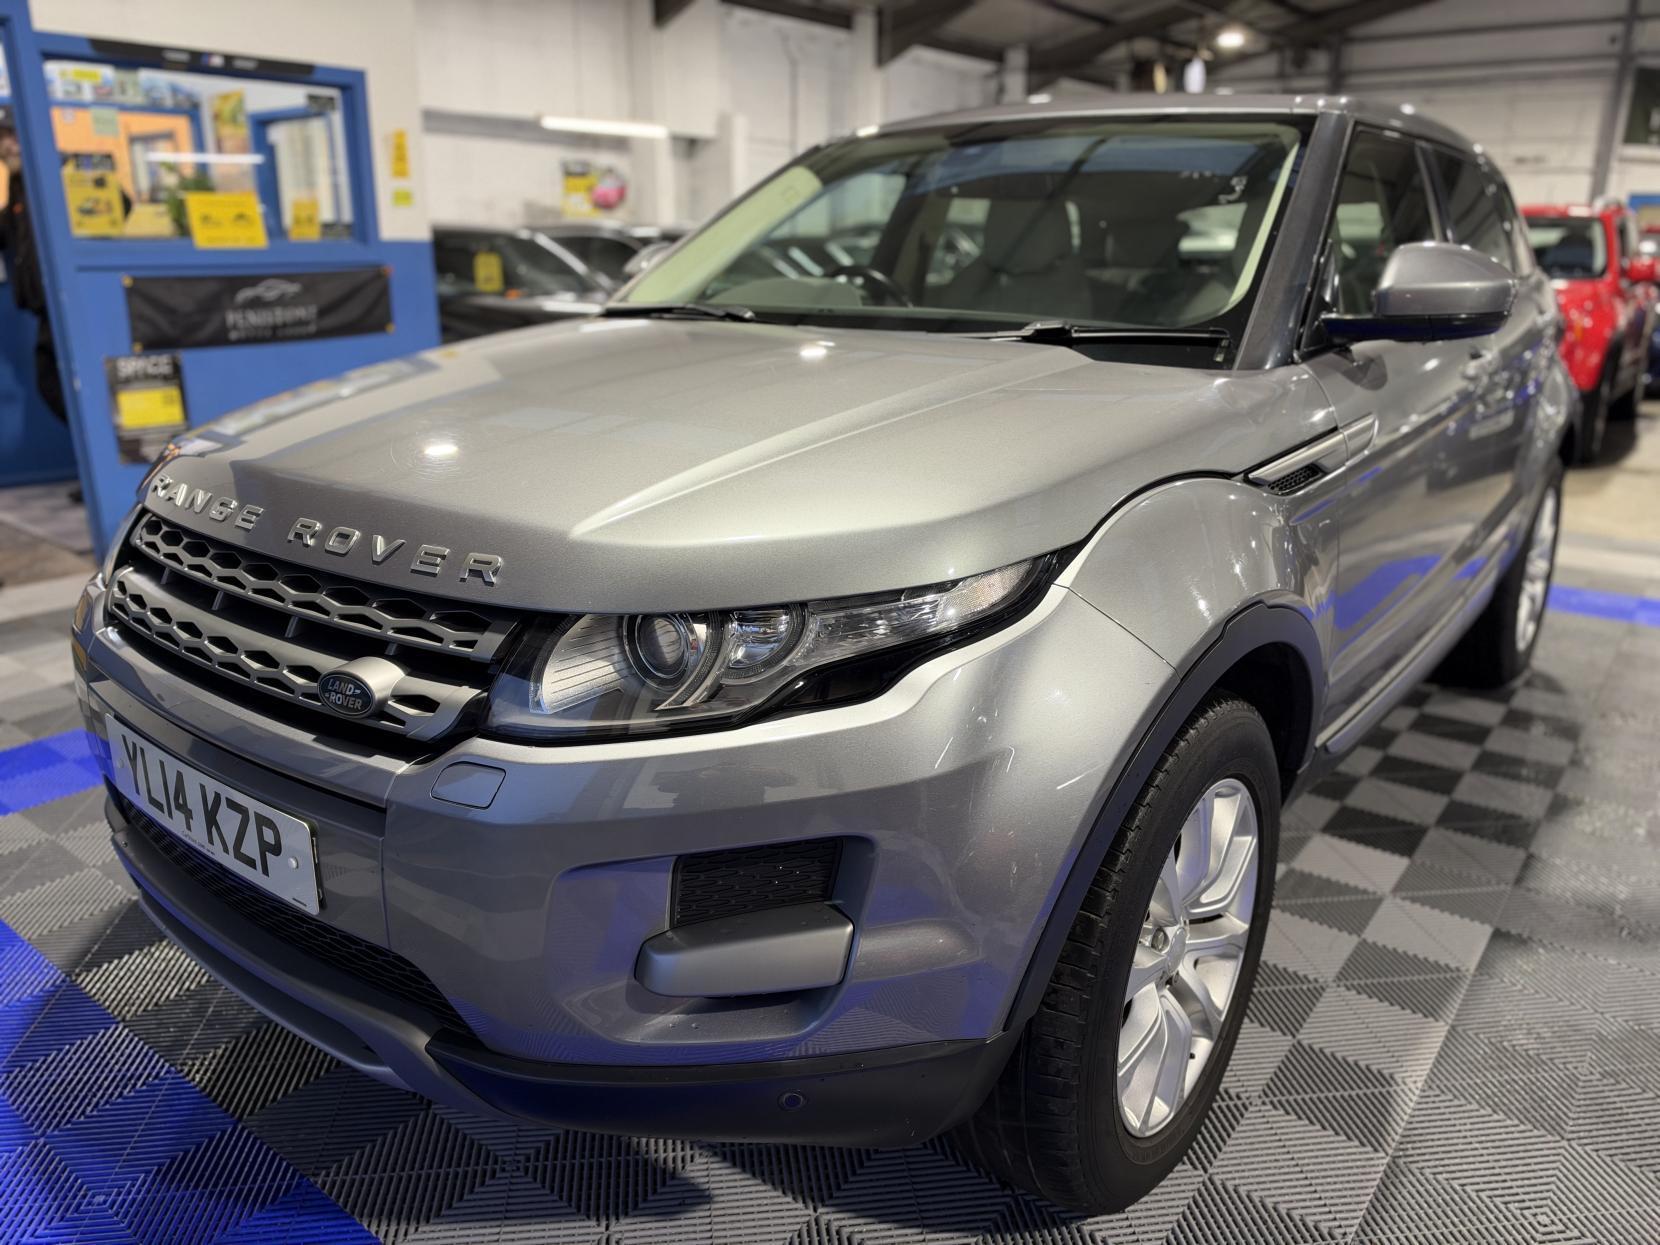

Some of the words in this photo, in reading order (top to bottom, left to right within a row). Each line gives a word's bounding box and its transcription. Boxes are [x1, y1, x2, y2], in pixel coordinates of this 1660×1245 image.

[152, 475, 264, 530] RANGE
[287, 518, 504, 587] ROVER
[121, 734, 194, 832] YL14
[200, 782, 283, 878] KZP
